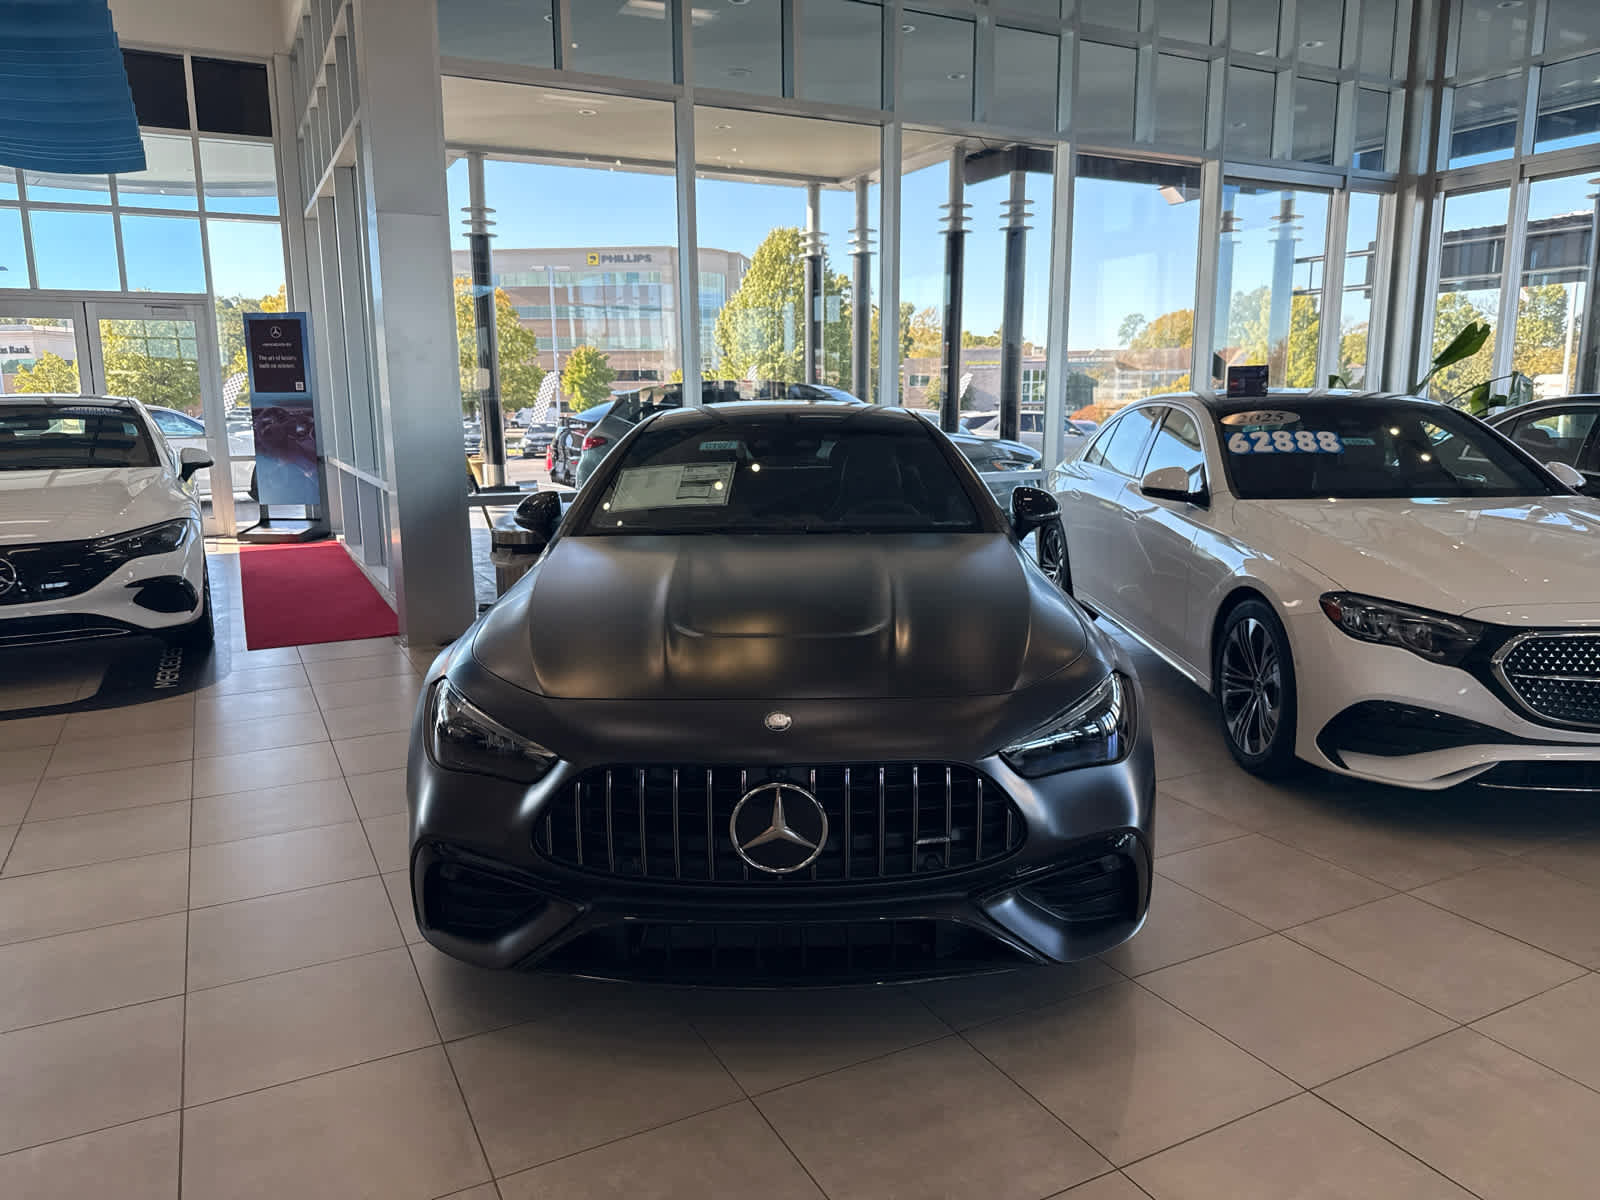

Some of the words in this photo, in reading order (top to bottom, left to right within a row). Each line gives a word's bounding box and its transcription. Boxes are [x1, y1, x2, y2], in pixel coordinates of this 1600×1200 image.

[601, 254, 652, 263] PHILLIPS
[9, 345, 31, 354] Bank
[1238, 412, 1285, 424] 2025
[1228, 430, 1342, 454] 62888
